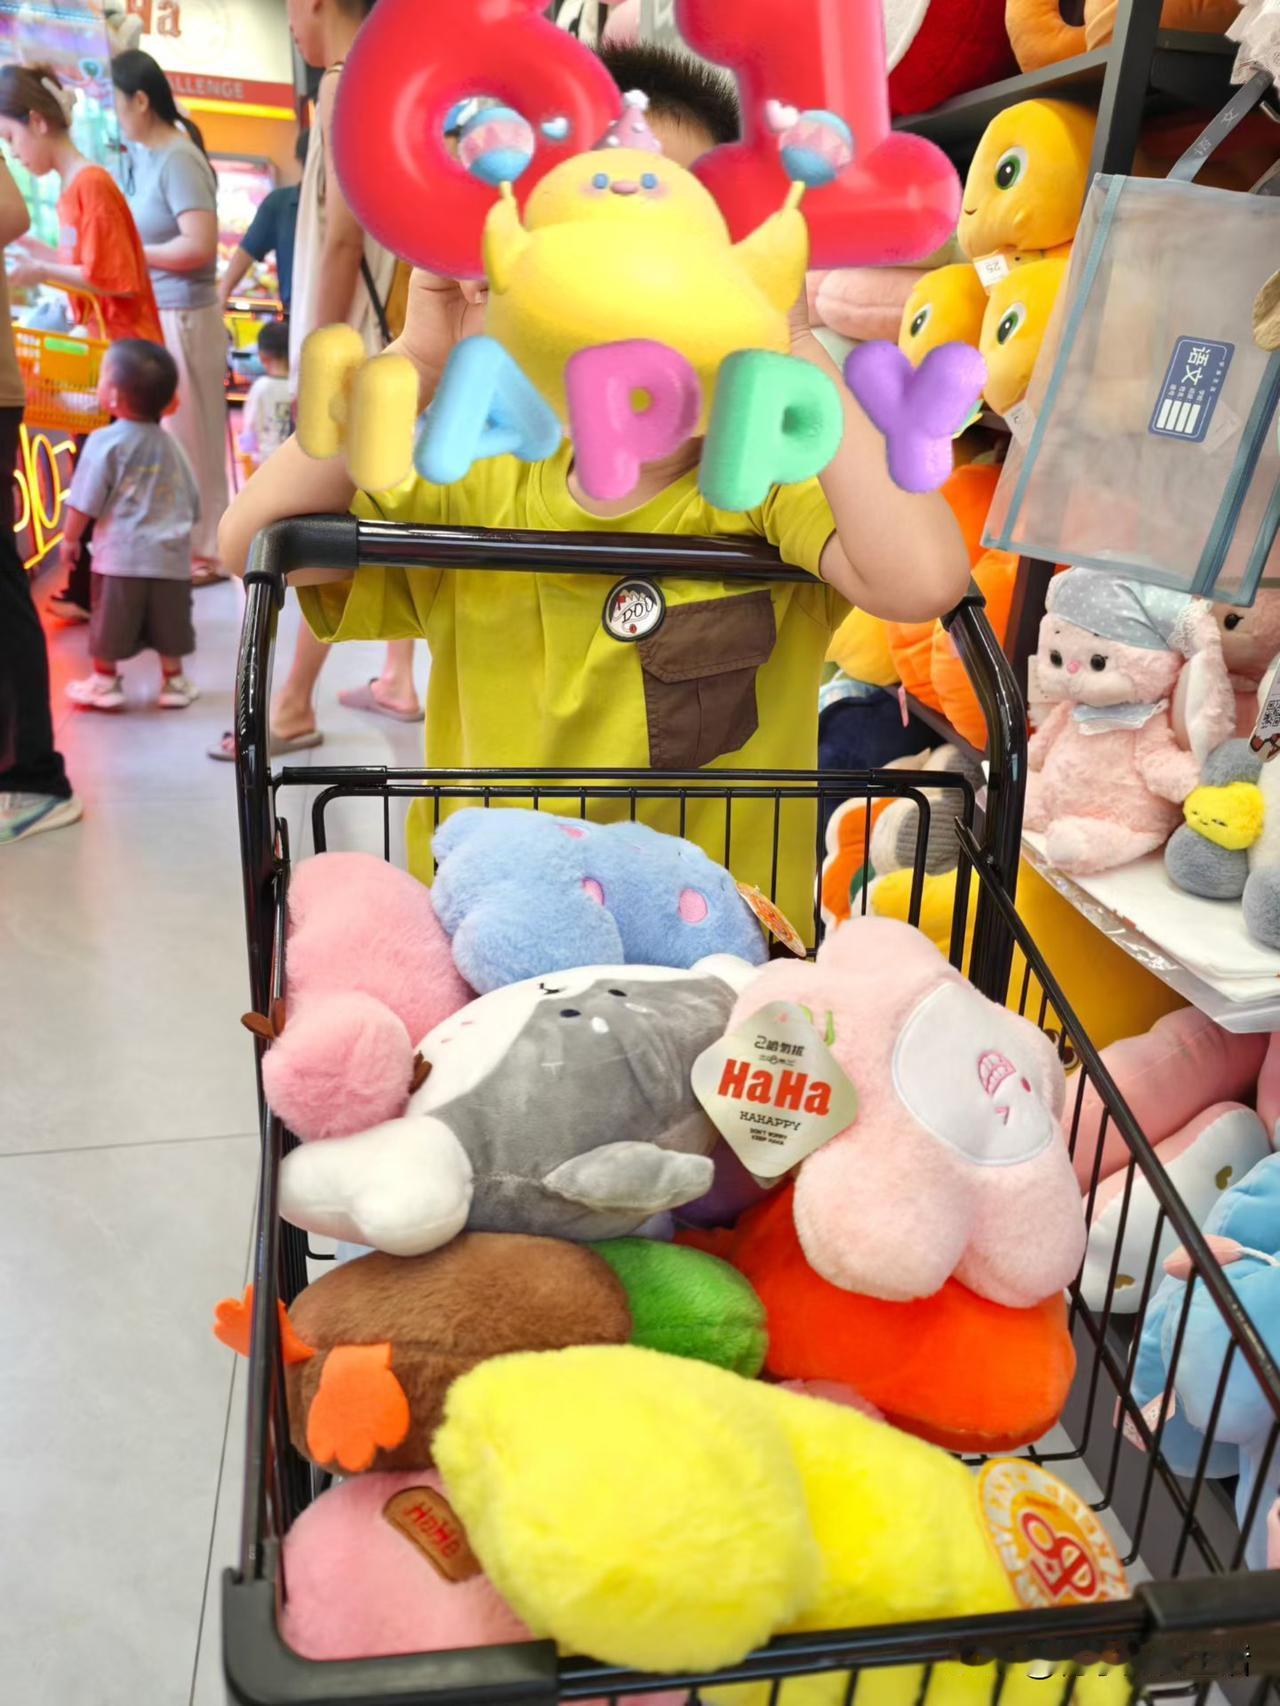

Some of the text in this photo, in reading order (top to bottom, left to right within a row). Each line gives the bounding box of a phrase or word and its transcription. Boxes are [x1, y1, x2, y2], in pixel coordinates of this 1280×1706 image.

[168, 76, 244, 99] LLENGE
[1181, 346, 1211, 386] 语文
[718, 1058, 832, 1116] HaHa
[739, 1110, 802, 1131] HAHAPPY
